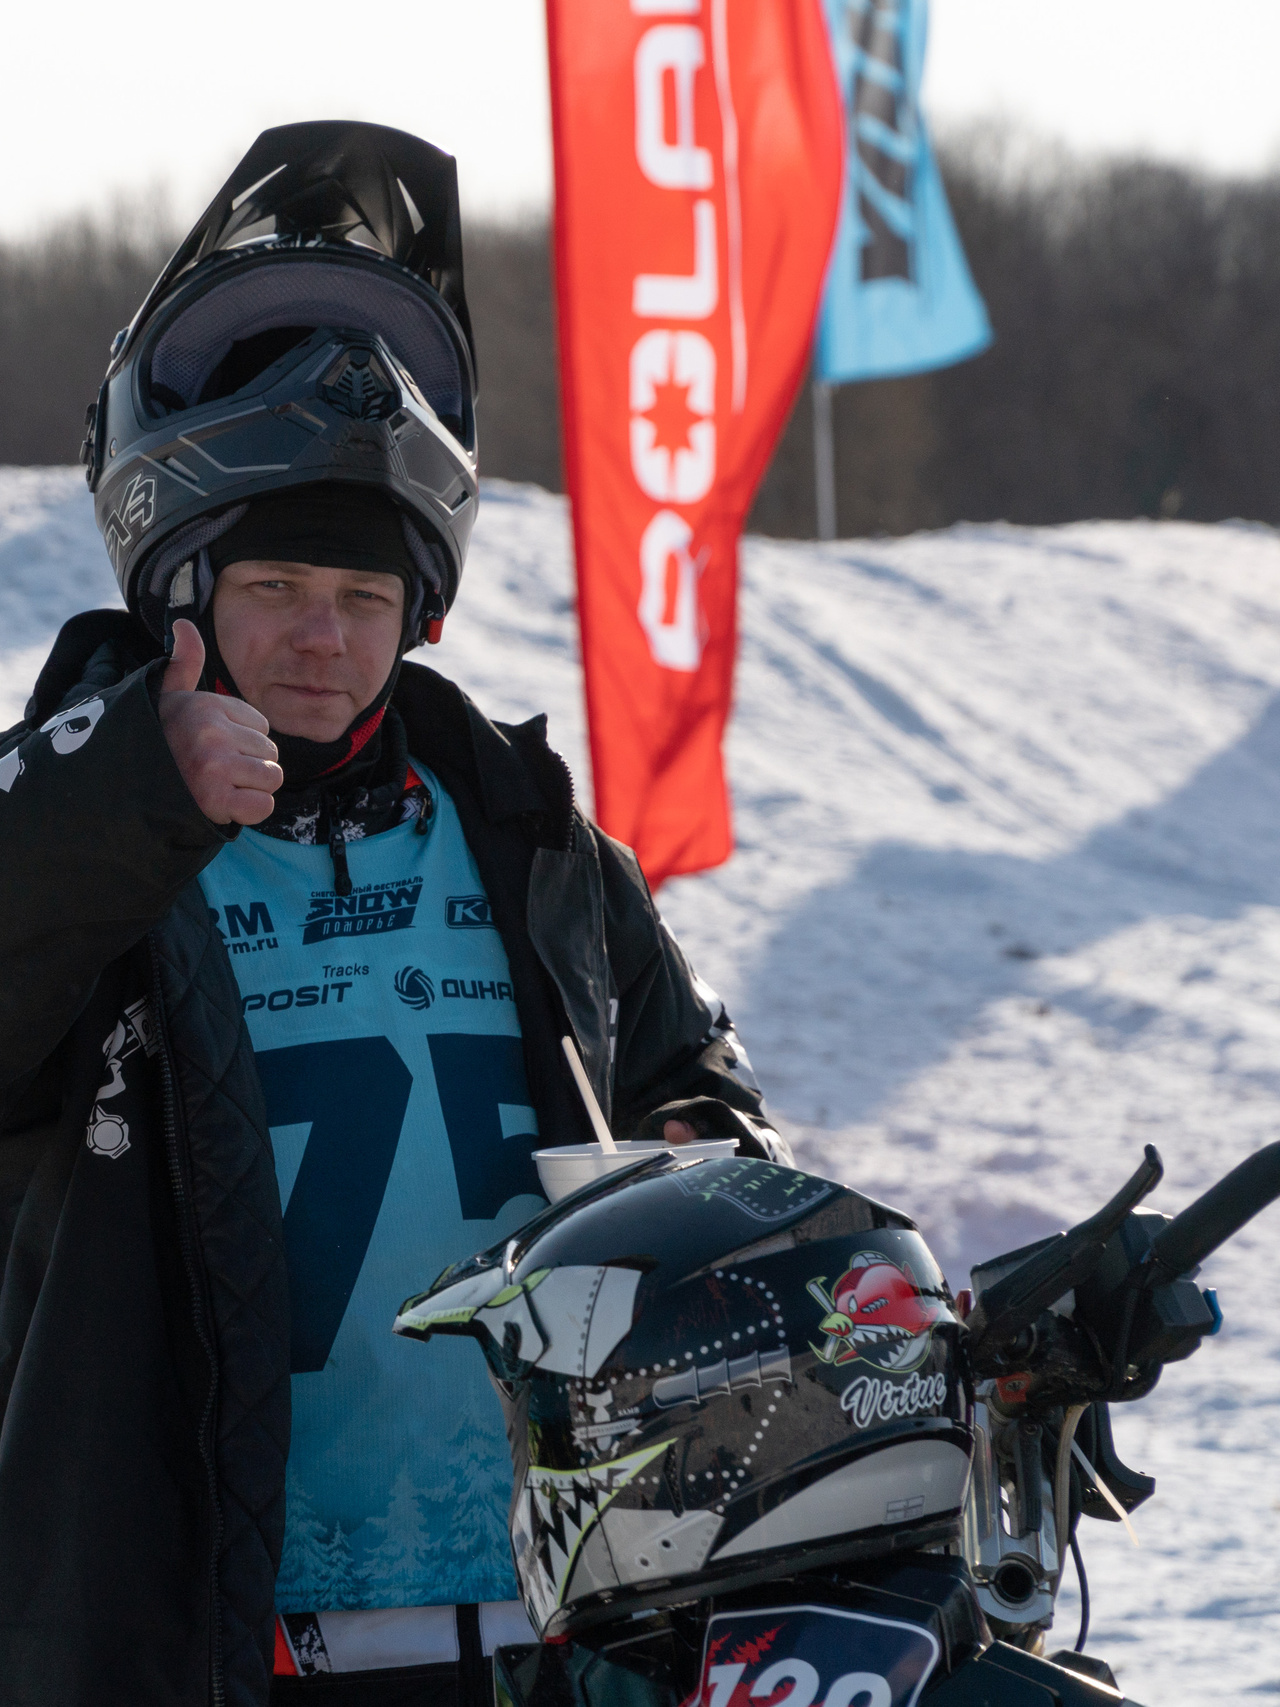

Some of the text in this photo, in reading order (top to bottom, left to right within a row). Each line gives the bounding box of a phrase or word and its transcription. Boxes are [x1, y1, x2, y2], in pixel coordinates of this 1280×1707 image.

[630, 0, 718, 672] POLA
[310, 876, 424, 898] СНЕГОНЫЙ ФЕСТИВАЛЬ
[305, 884, 423, 922] SNOW
[322, 914, 396, 935] ПОМОРЬЕ
[322, 963, 370, 979] Tracks
[841, 1371, 948, 1429] Virtue
